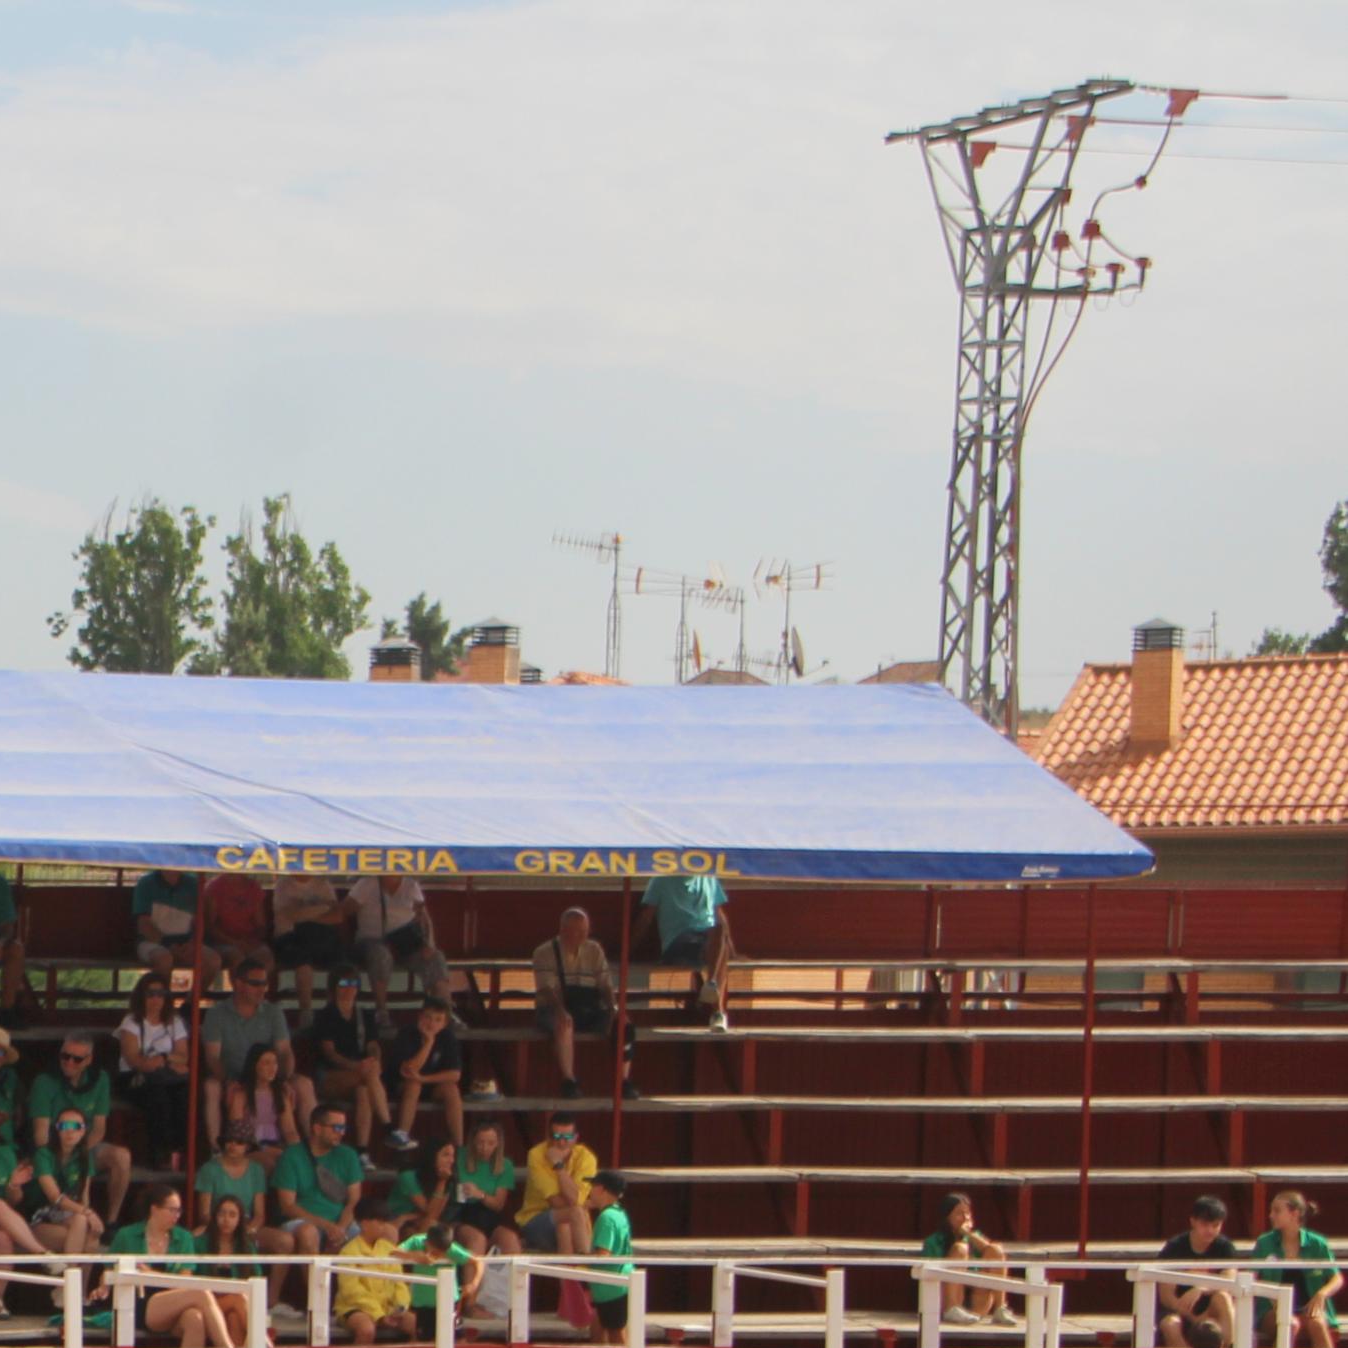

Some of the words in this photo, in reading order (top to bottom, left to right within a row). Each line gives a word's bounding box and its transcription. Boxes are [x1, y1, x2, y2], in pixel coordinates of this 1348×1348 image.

[215, 846, 460, 873] CAFETERIA
[514, 850, 637, 875] GRAN
[651, 850, 741, 877] SOL
